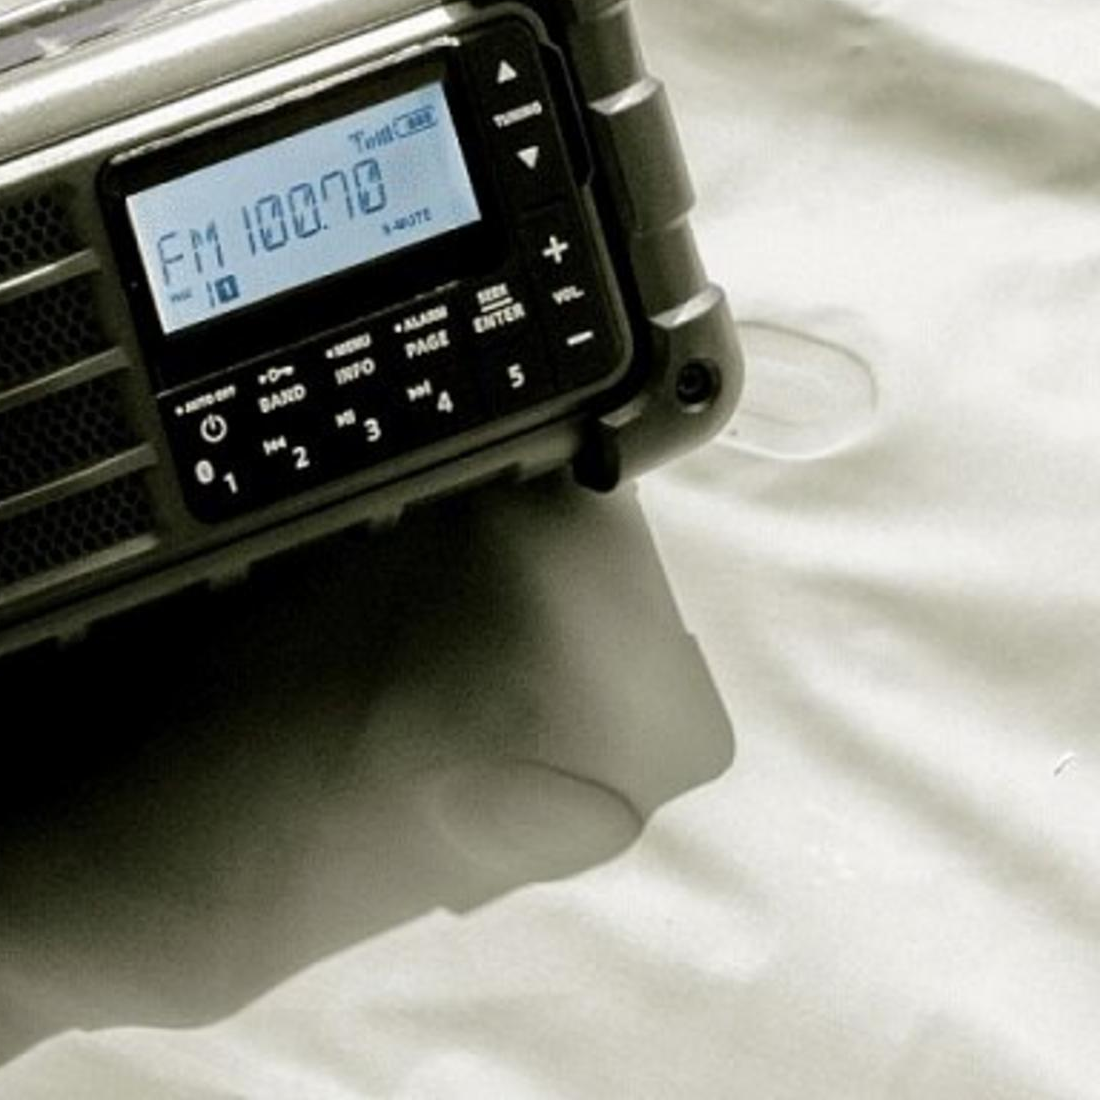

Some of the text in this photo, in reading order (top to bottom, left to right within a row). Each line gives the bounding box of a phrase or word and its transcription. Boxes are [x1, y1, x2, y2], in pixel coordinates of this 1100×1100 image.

[157, 222, 225, 287] FM
[403, 305, 448, 333] ALARM
[472, 302, 526, 333] ENTER
[334, 333, 372, 357] MENU
[404, 329, 450, 359] PAGE
[334, 357, 376, 386] INFO
[507, 363, 525, 389] 5
[258, 384, 307, 414] BAND
[436, 391, 454, 413] 4
[363, 418, 382, 443] 3
[291, 445, 311, 470] 2
[223, 471, 238, 494] 1
